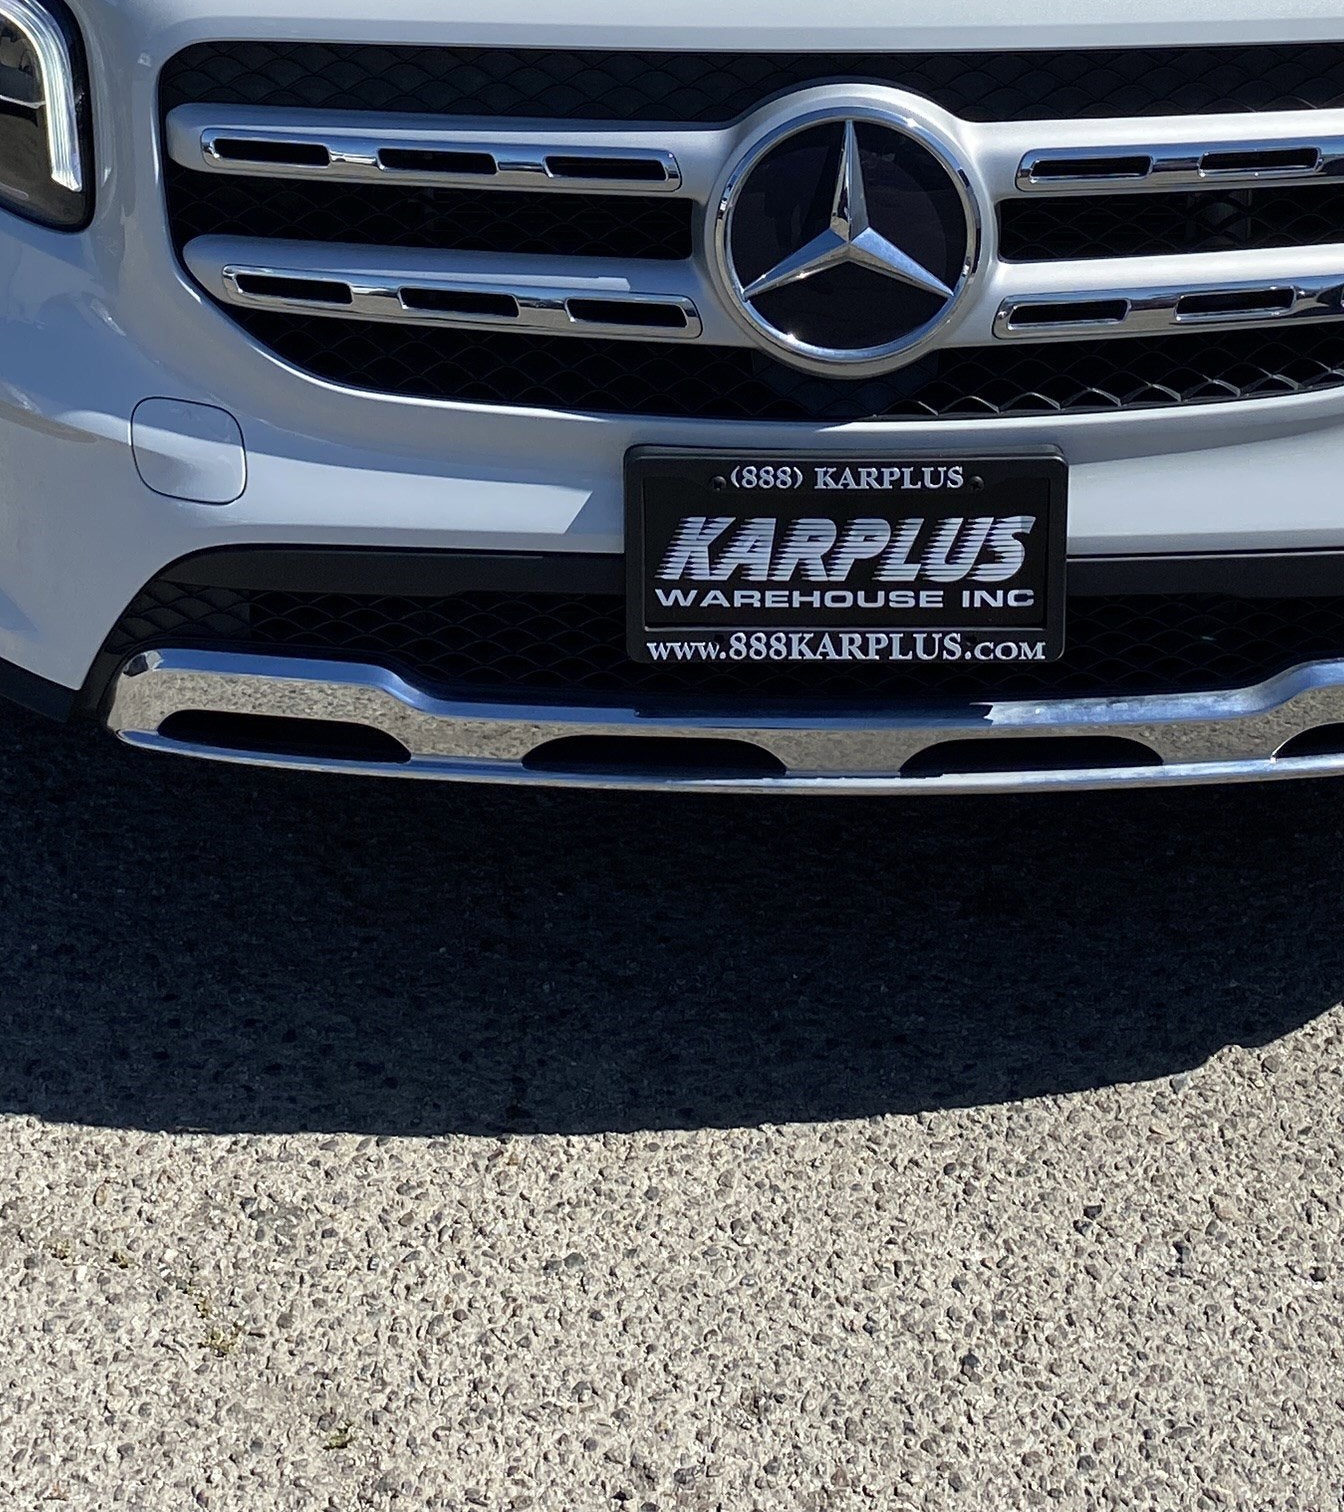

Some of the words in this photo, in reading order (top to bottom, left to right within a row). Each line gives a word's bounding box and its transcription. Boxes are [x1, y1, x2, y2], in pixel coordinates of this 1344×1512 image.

[730, 465, 803, 489] (888)
[814, 466, 964, 490] KARPLUS
[655, 516, 1036, 583] KARPLUS
[656, 589, 944, 609] WAREHOUSE
[962, 589, 1034, 608] INC
